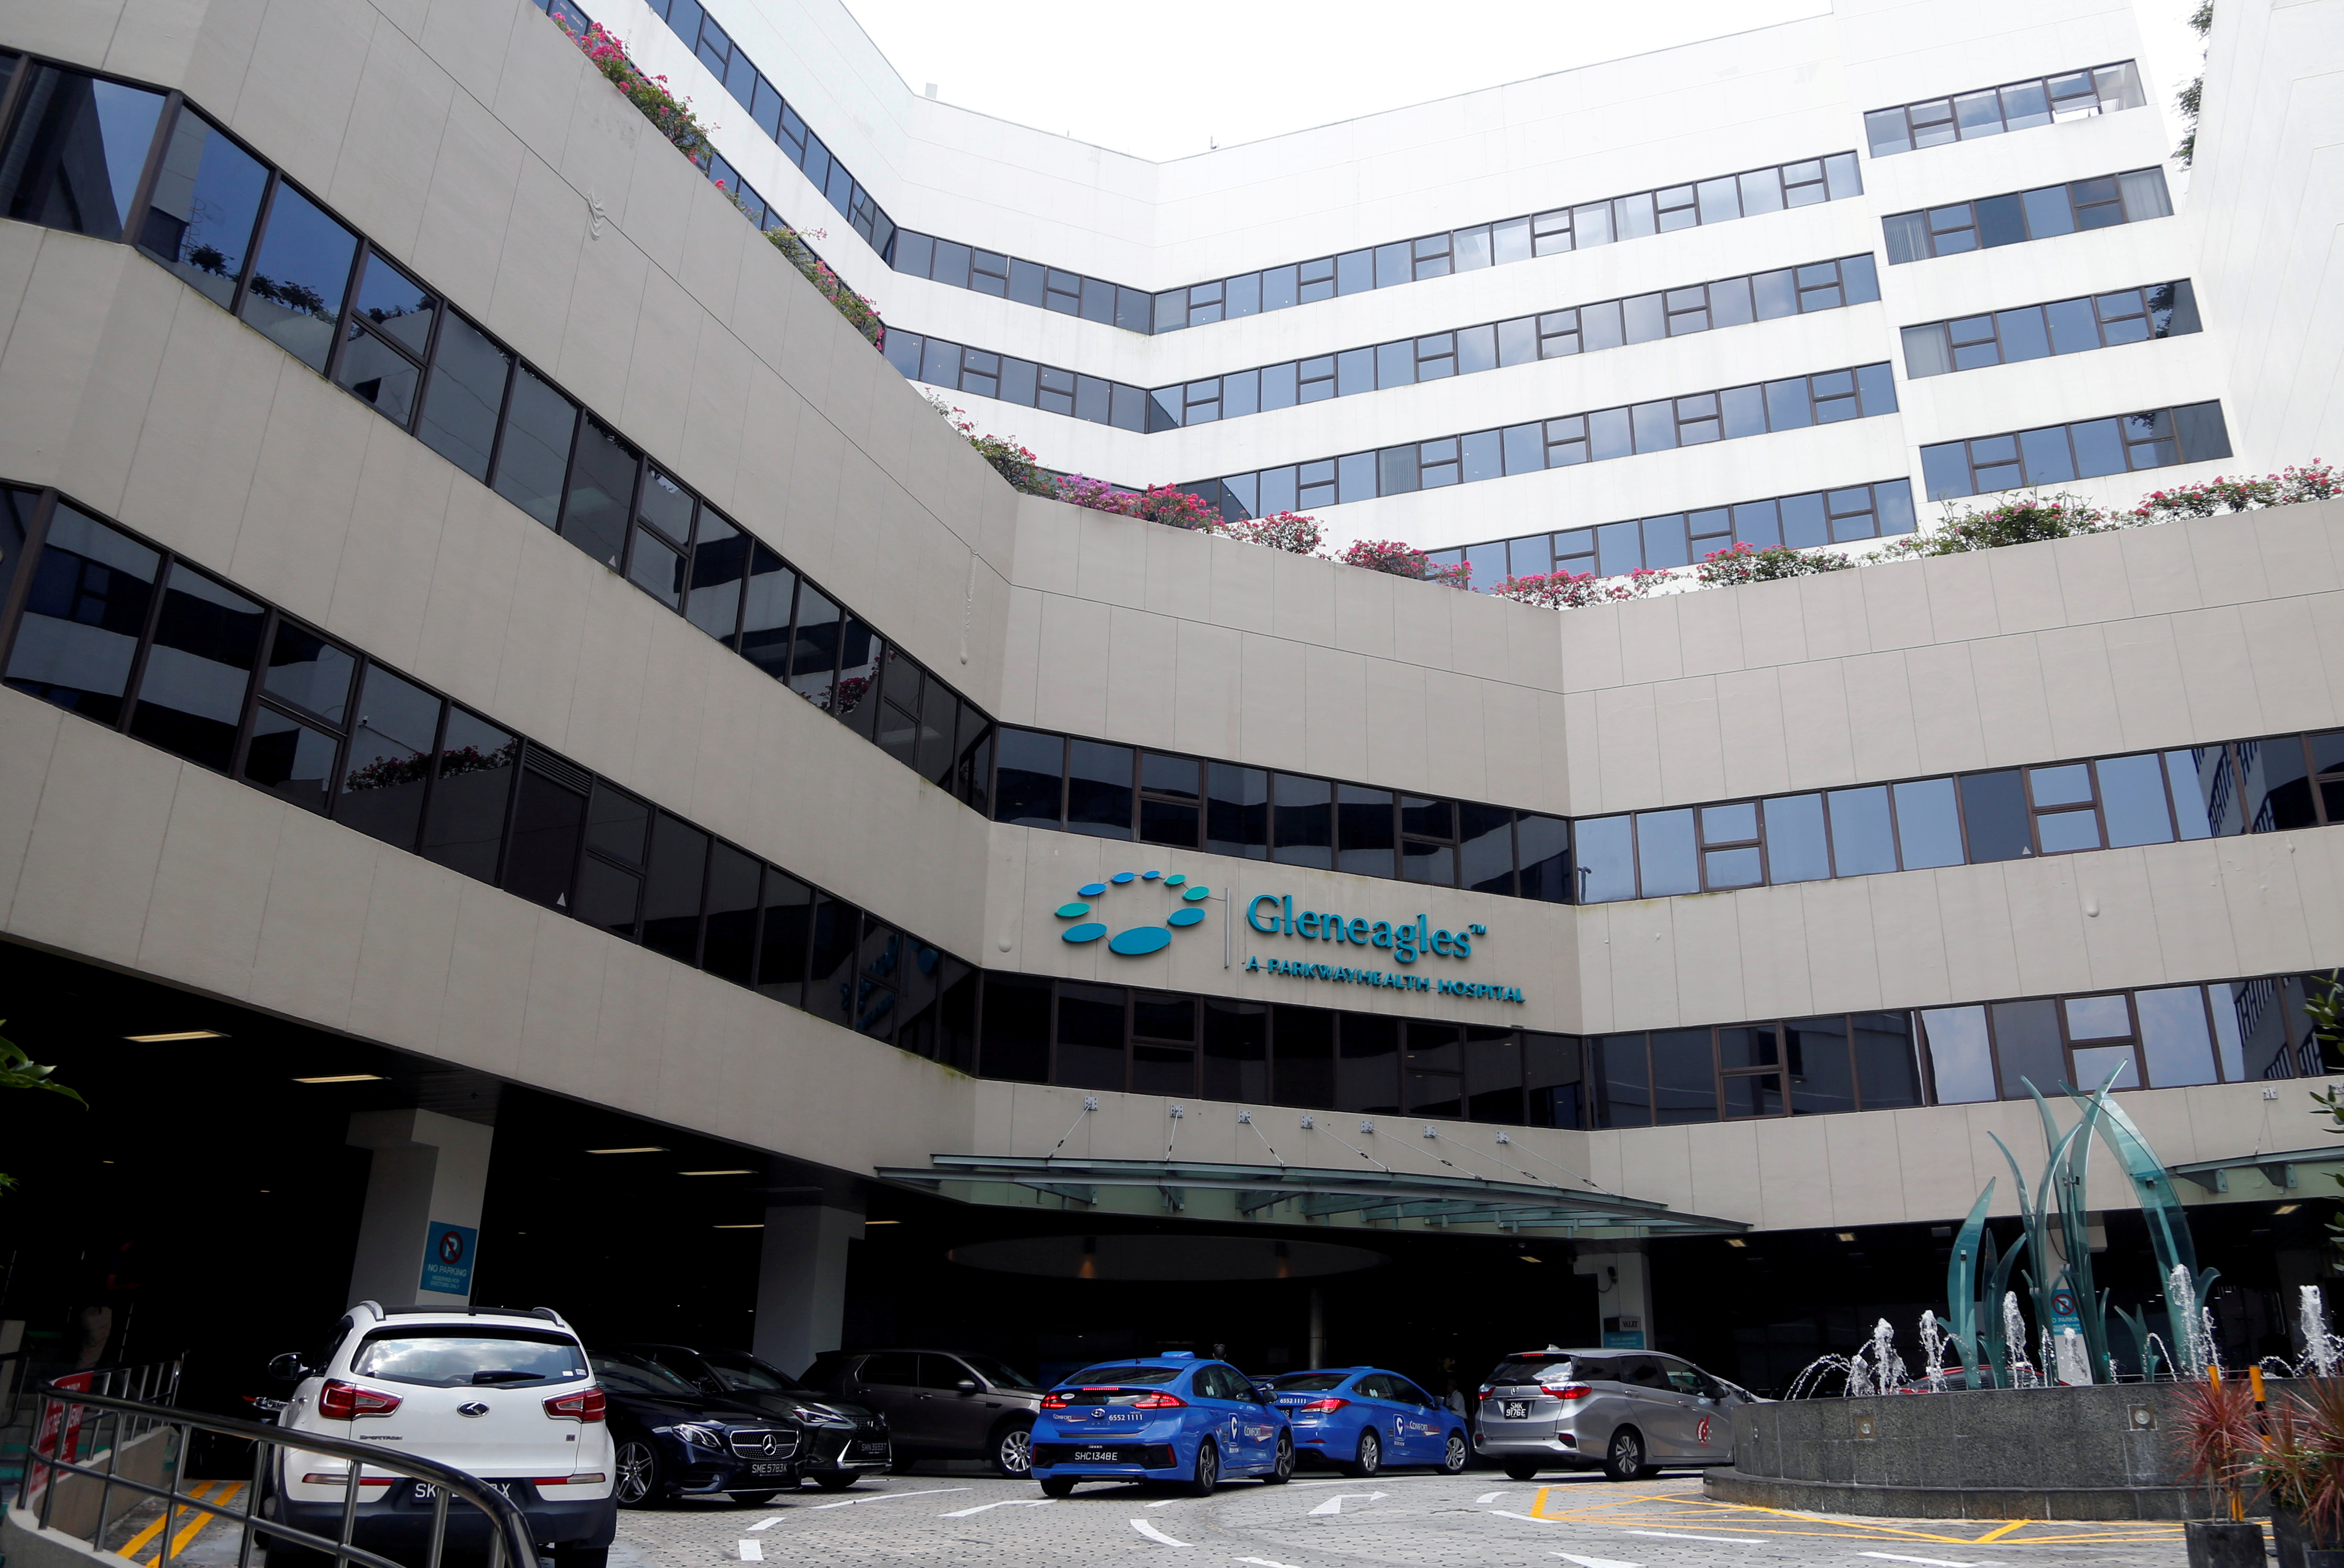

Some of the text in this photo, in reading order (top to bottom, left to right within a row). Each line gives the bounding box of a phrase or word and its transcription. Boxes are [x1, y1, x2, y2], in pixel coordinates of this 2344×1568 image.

[1246, 956, 1526, 1002] A PARKWAYHEALTH HOSPITAL
[427, 1264, 467, 1277] NO PARKING
[1075, 1452, 1118, 1461] SHC1348E
